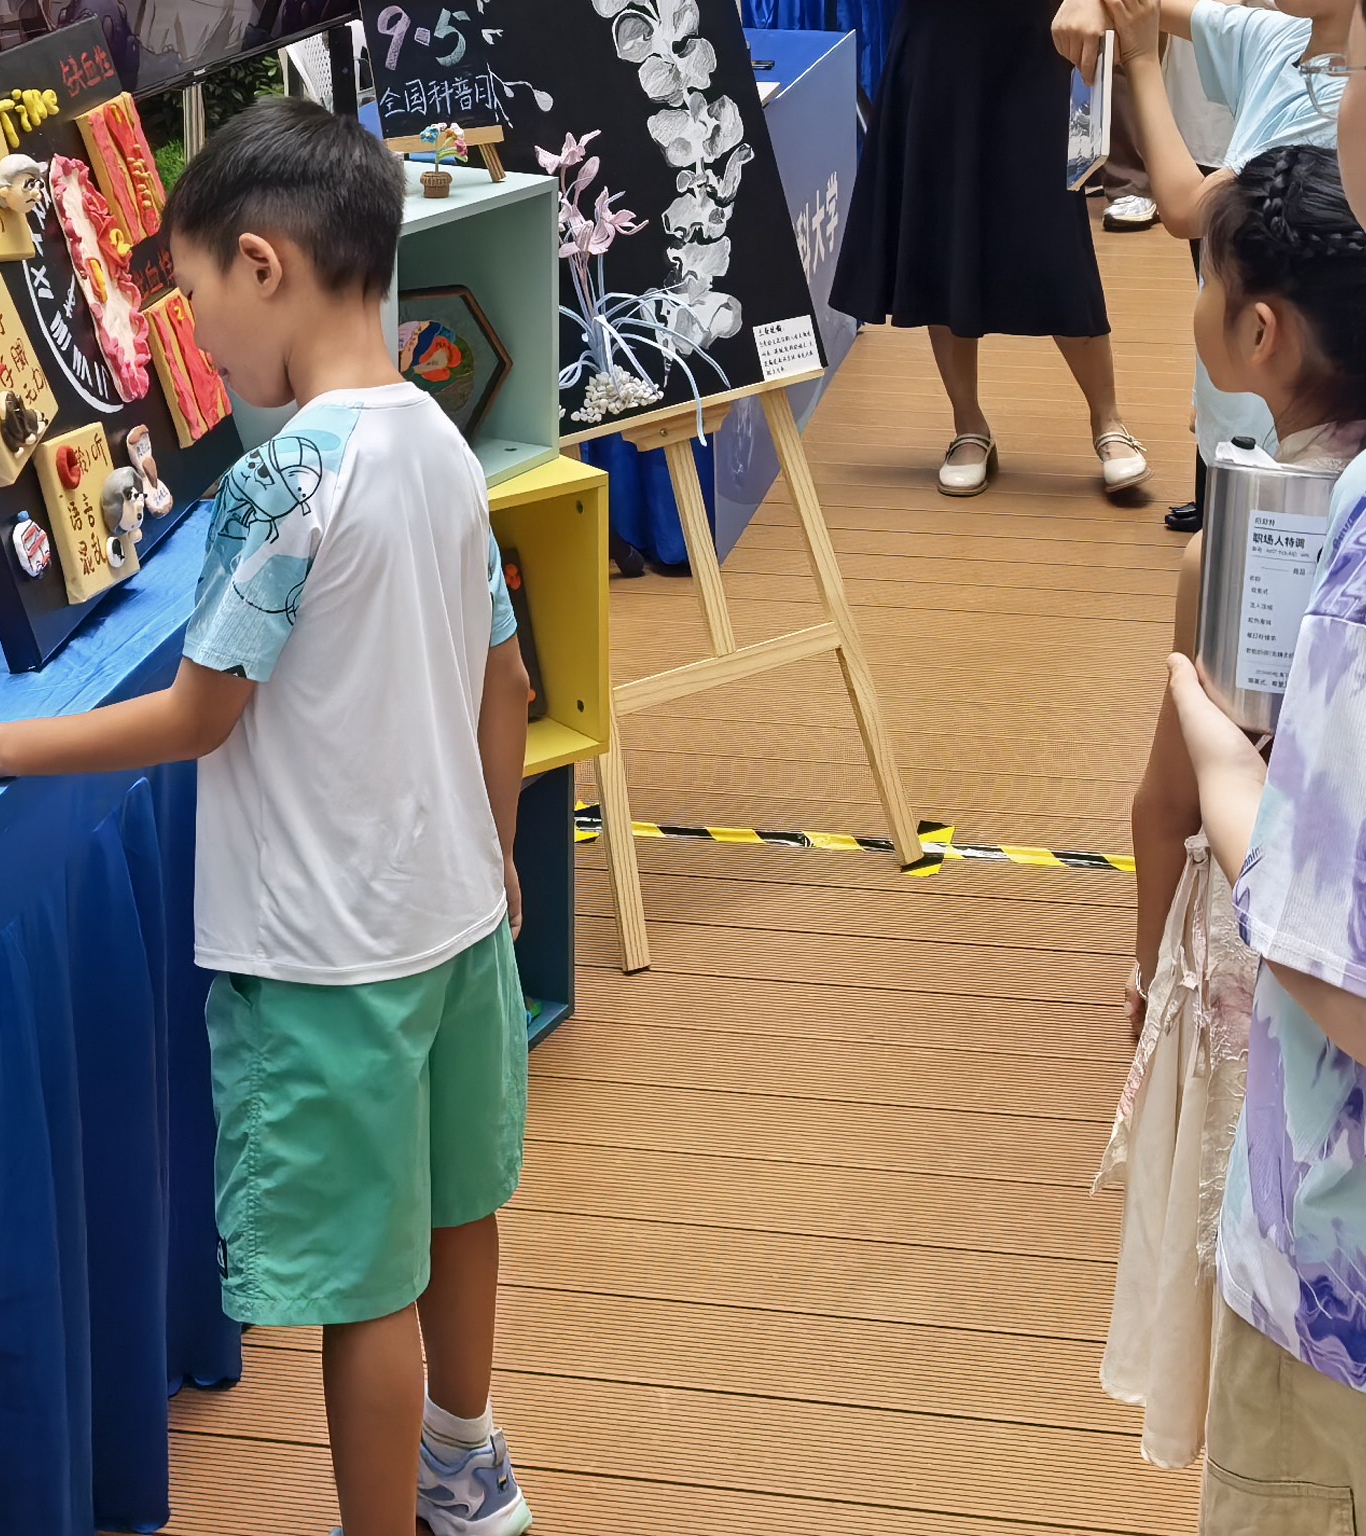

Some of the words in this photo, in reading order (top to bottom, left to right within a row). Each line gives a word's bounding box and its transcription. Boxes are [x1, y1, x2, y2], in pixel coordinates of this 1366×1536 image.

[1253, 532, 1305, 549] 职场人特调
